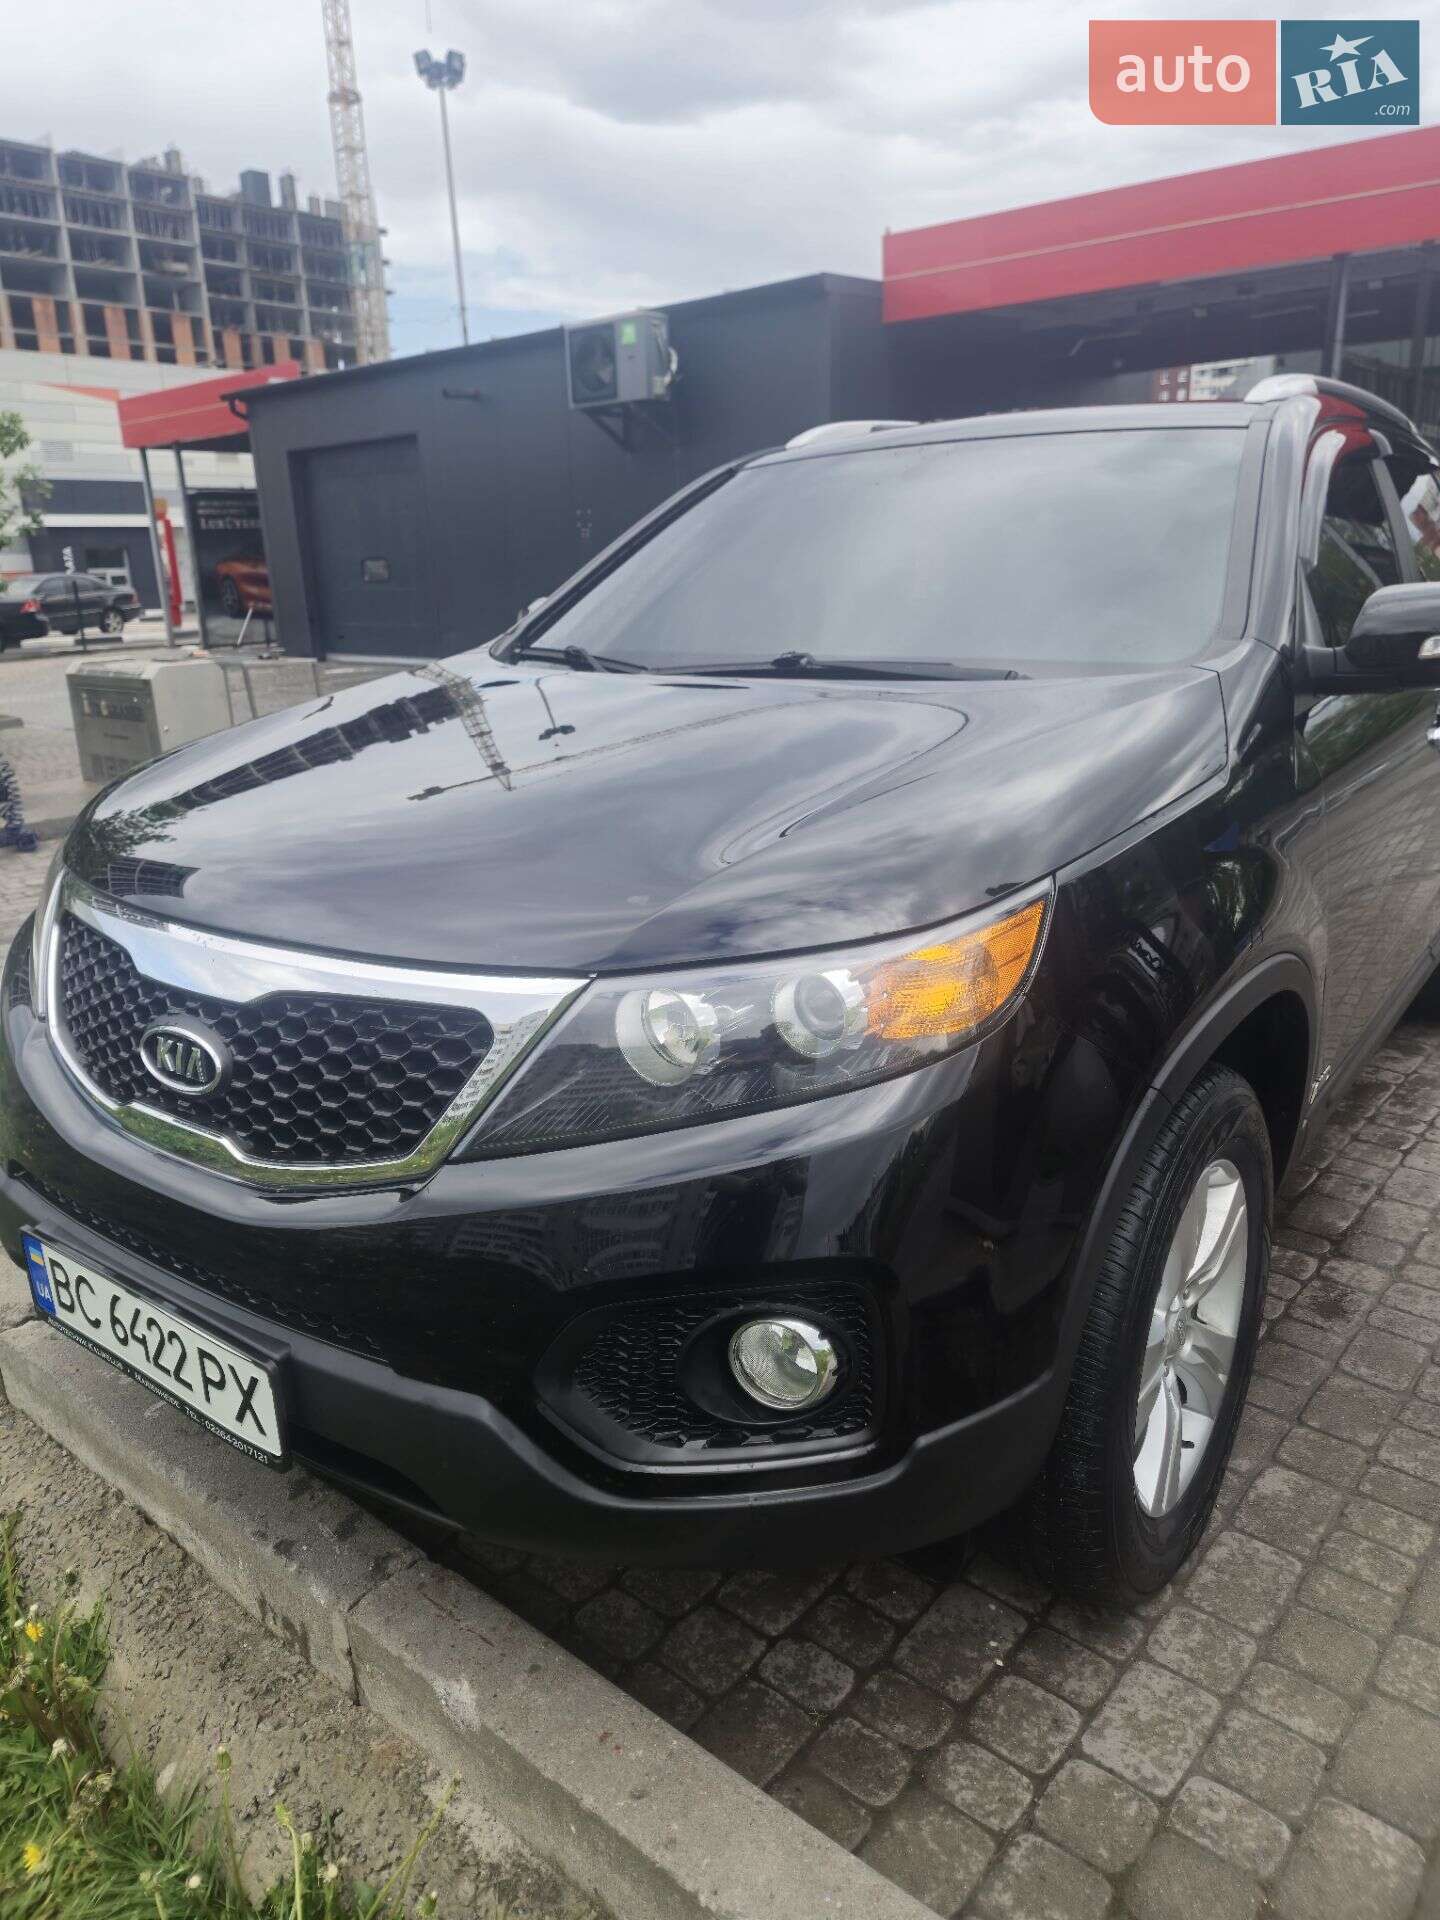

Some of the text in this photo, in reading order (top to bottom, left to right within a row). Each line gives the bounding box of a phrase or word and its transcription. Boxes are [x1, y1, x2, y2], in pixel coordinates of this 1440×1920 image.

[156, 1035, 206, 1084] KIA
[36, 1281, 53, 1304] UA
[48, 1257, 102, 1330] BC
[109, 1294, 194, 1392] 6422
[196, 1346, 267, 1437] PX
